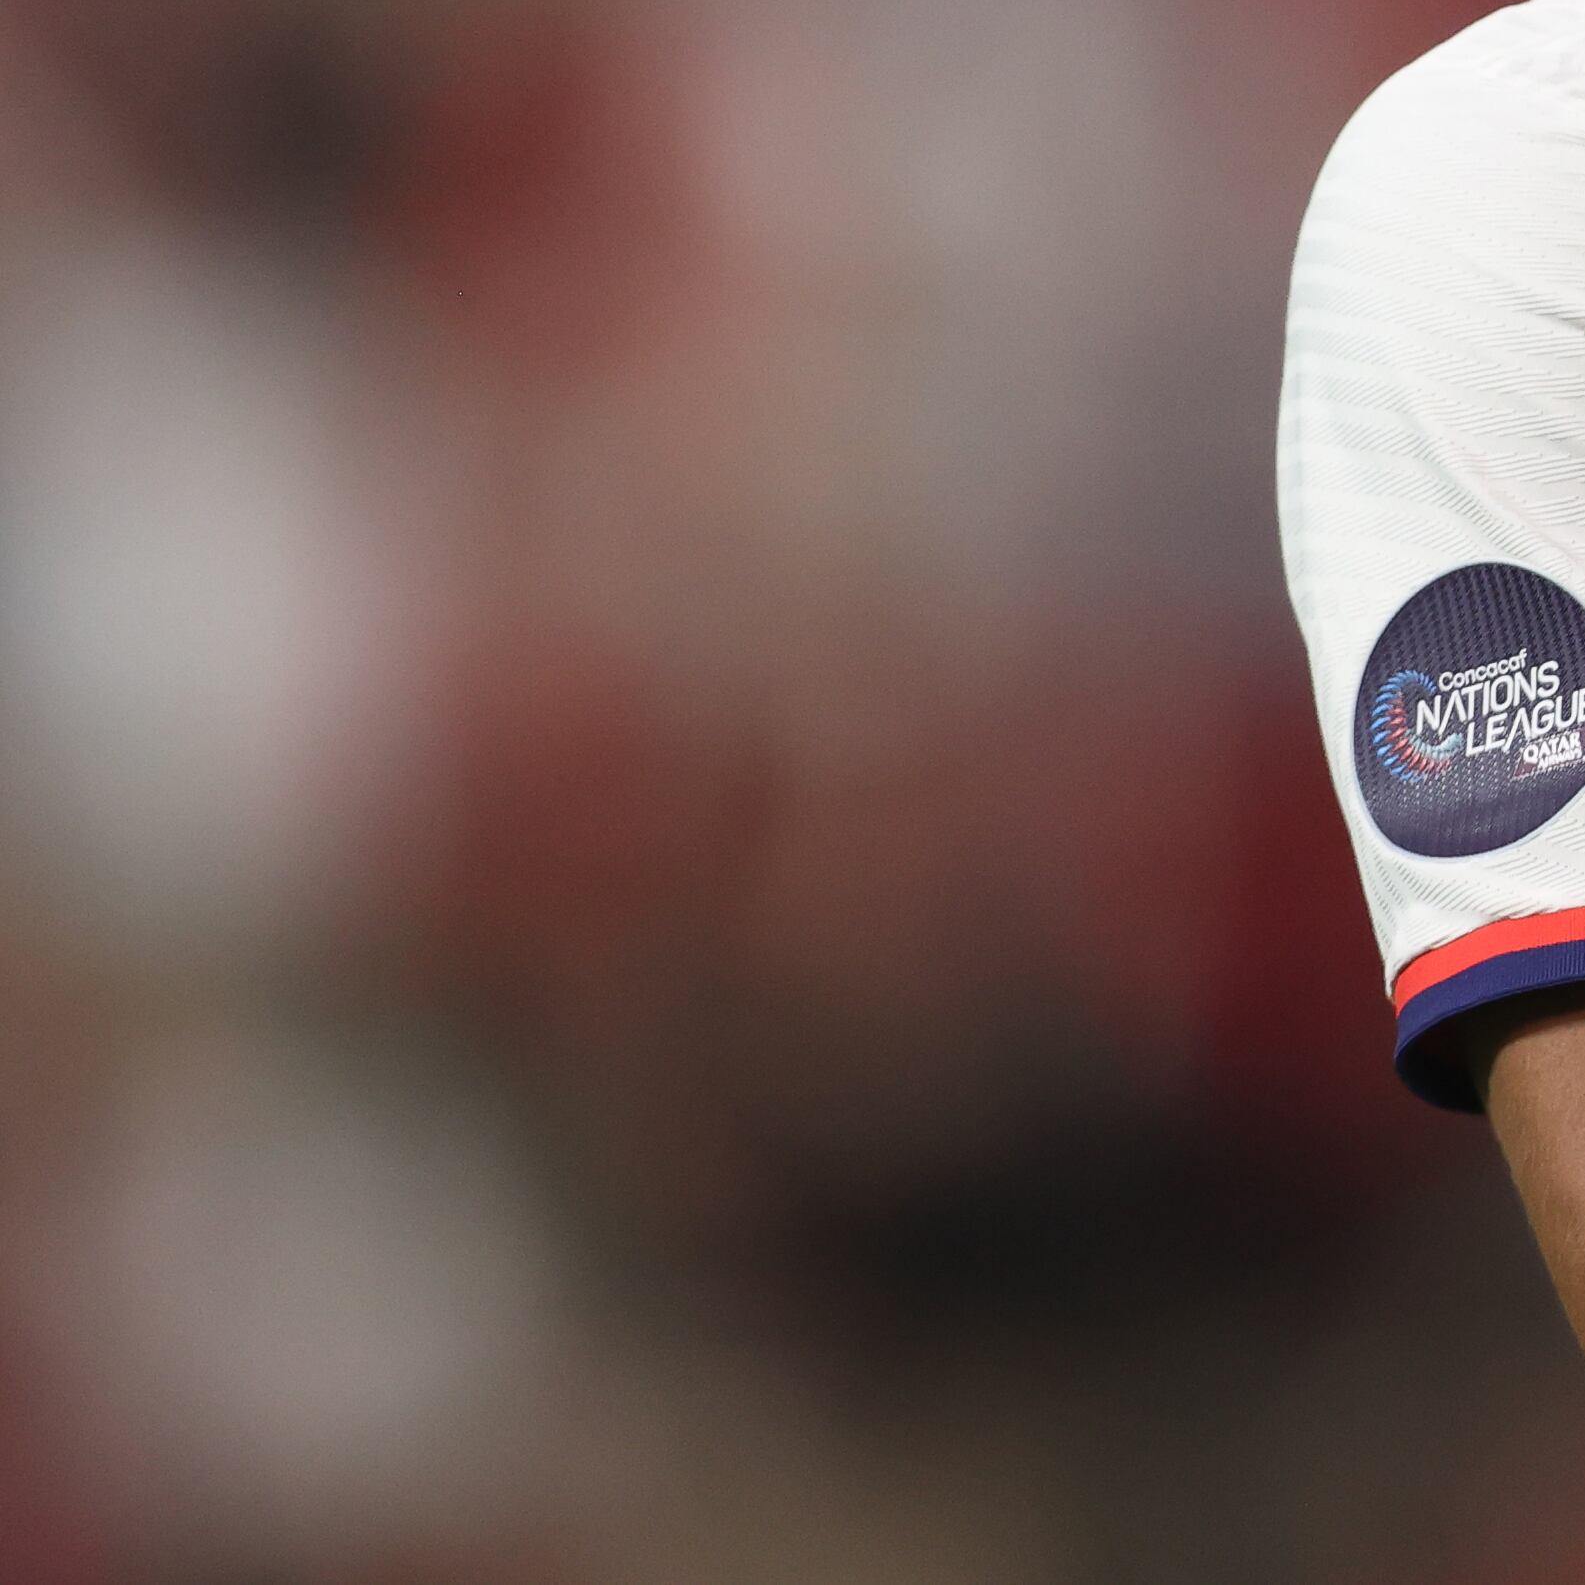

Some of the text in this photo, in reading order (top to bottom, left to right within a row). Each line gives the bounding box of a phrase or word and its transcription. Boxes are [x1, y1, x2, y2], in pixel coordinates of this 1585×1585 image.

[1438, 648, 1527, 692] Concacaf
[1415, 660, 1559, 736] NATIONS
[1523, 731, 1581, 764] QATAR
